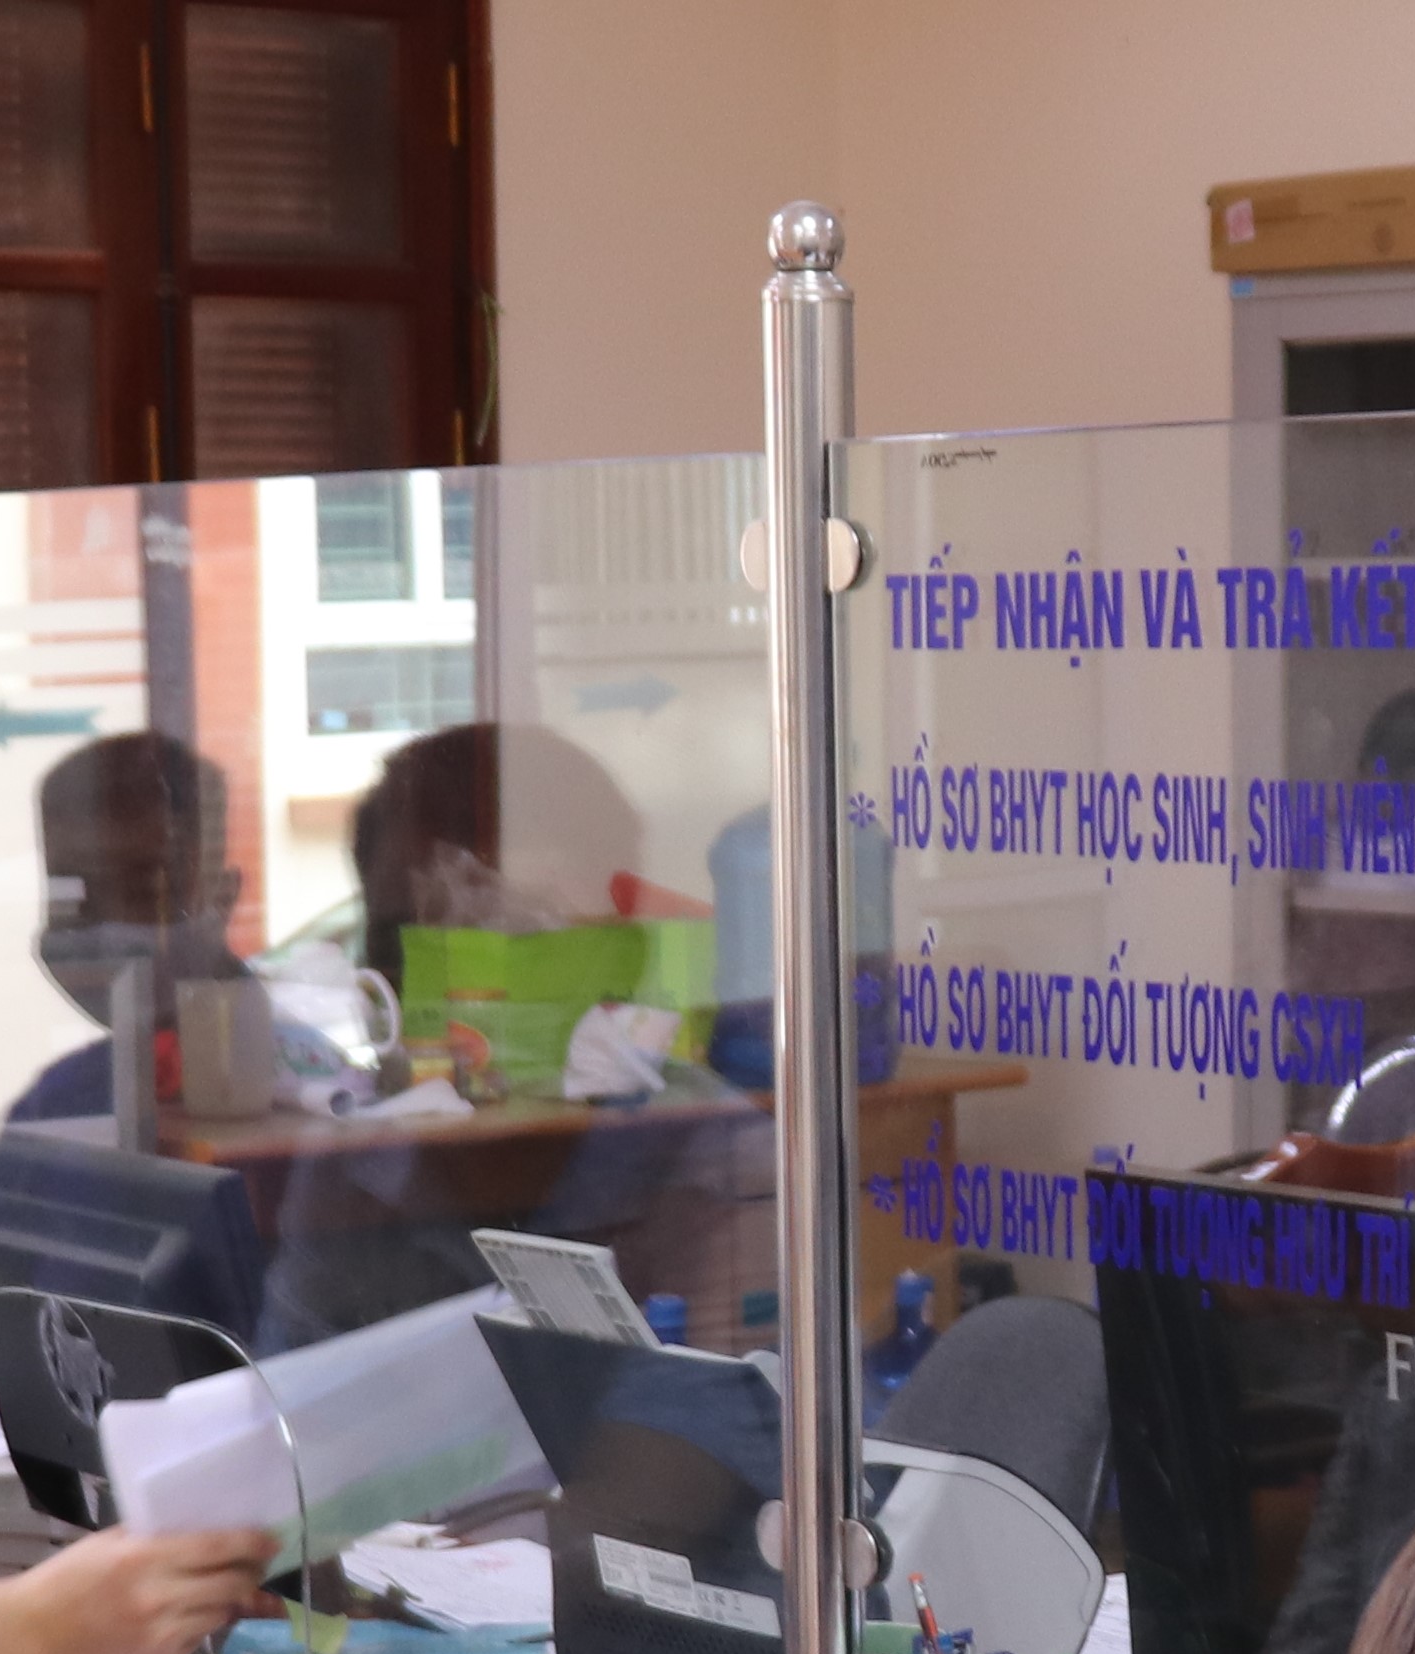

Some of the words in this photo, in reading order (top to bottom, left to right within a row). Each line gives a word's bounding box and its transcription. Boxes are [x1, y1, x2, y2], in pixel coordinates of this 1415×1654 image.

[886, 544, 980, 650] TIẾP
[995, 549, 1126, 669] NHẬN
[1140, 546, 1203, 650] VÀ
[1217, 527, 1313, 650] TRẢ
[891, 733, 932, 849] HỒ
[941, 763, 981, 852] SƠ
[990, 768, 1068, 856] BHYT
[1077, 770, 1143, 885] HỌC
[1249, 776, 1326, 872] SINH
[897, 927, 938, 1047] HỒ
[948, 963, 985, 1052] SƠ
[996, 969, 1074, 1059] BHYT
[1082, 940, 1137, 1066] ĐỐI
[1146, 972, 1260, 1100] TƯỢNG
[1271, 990, 1364, 1090] CSXH
[1001, 1168, 1078, 1261] BHYT
[1088, 1143, 1142, 1271] ĐỐI
[1355, 1190, 1412, 1309] TRÍ
